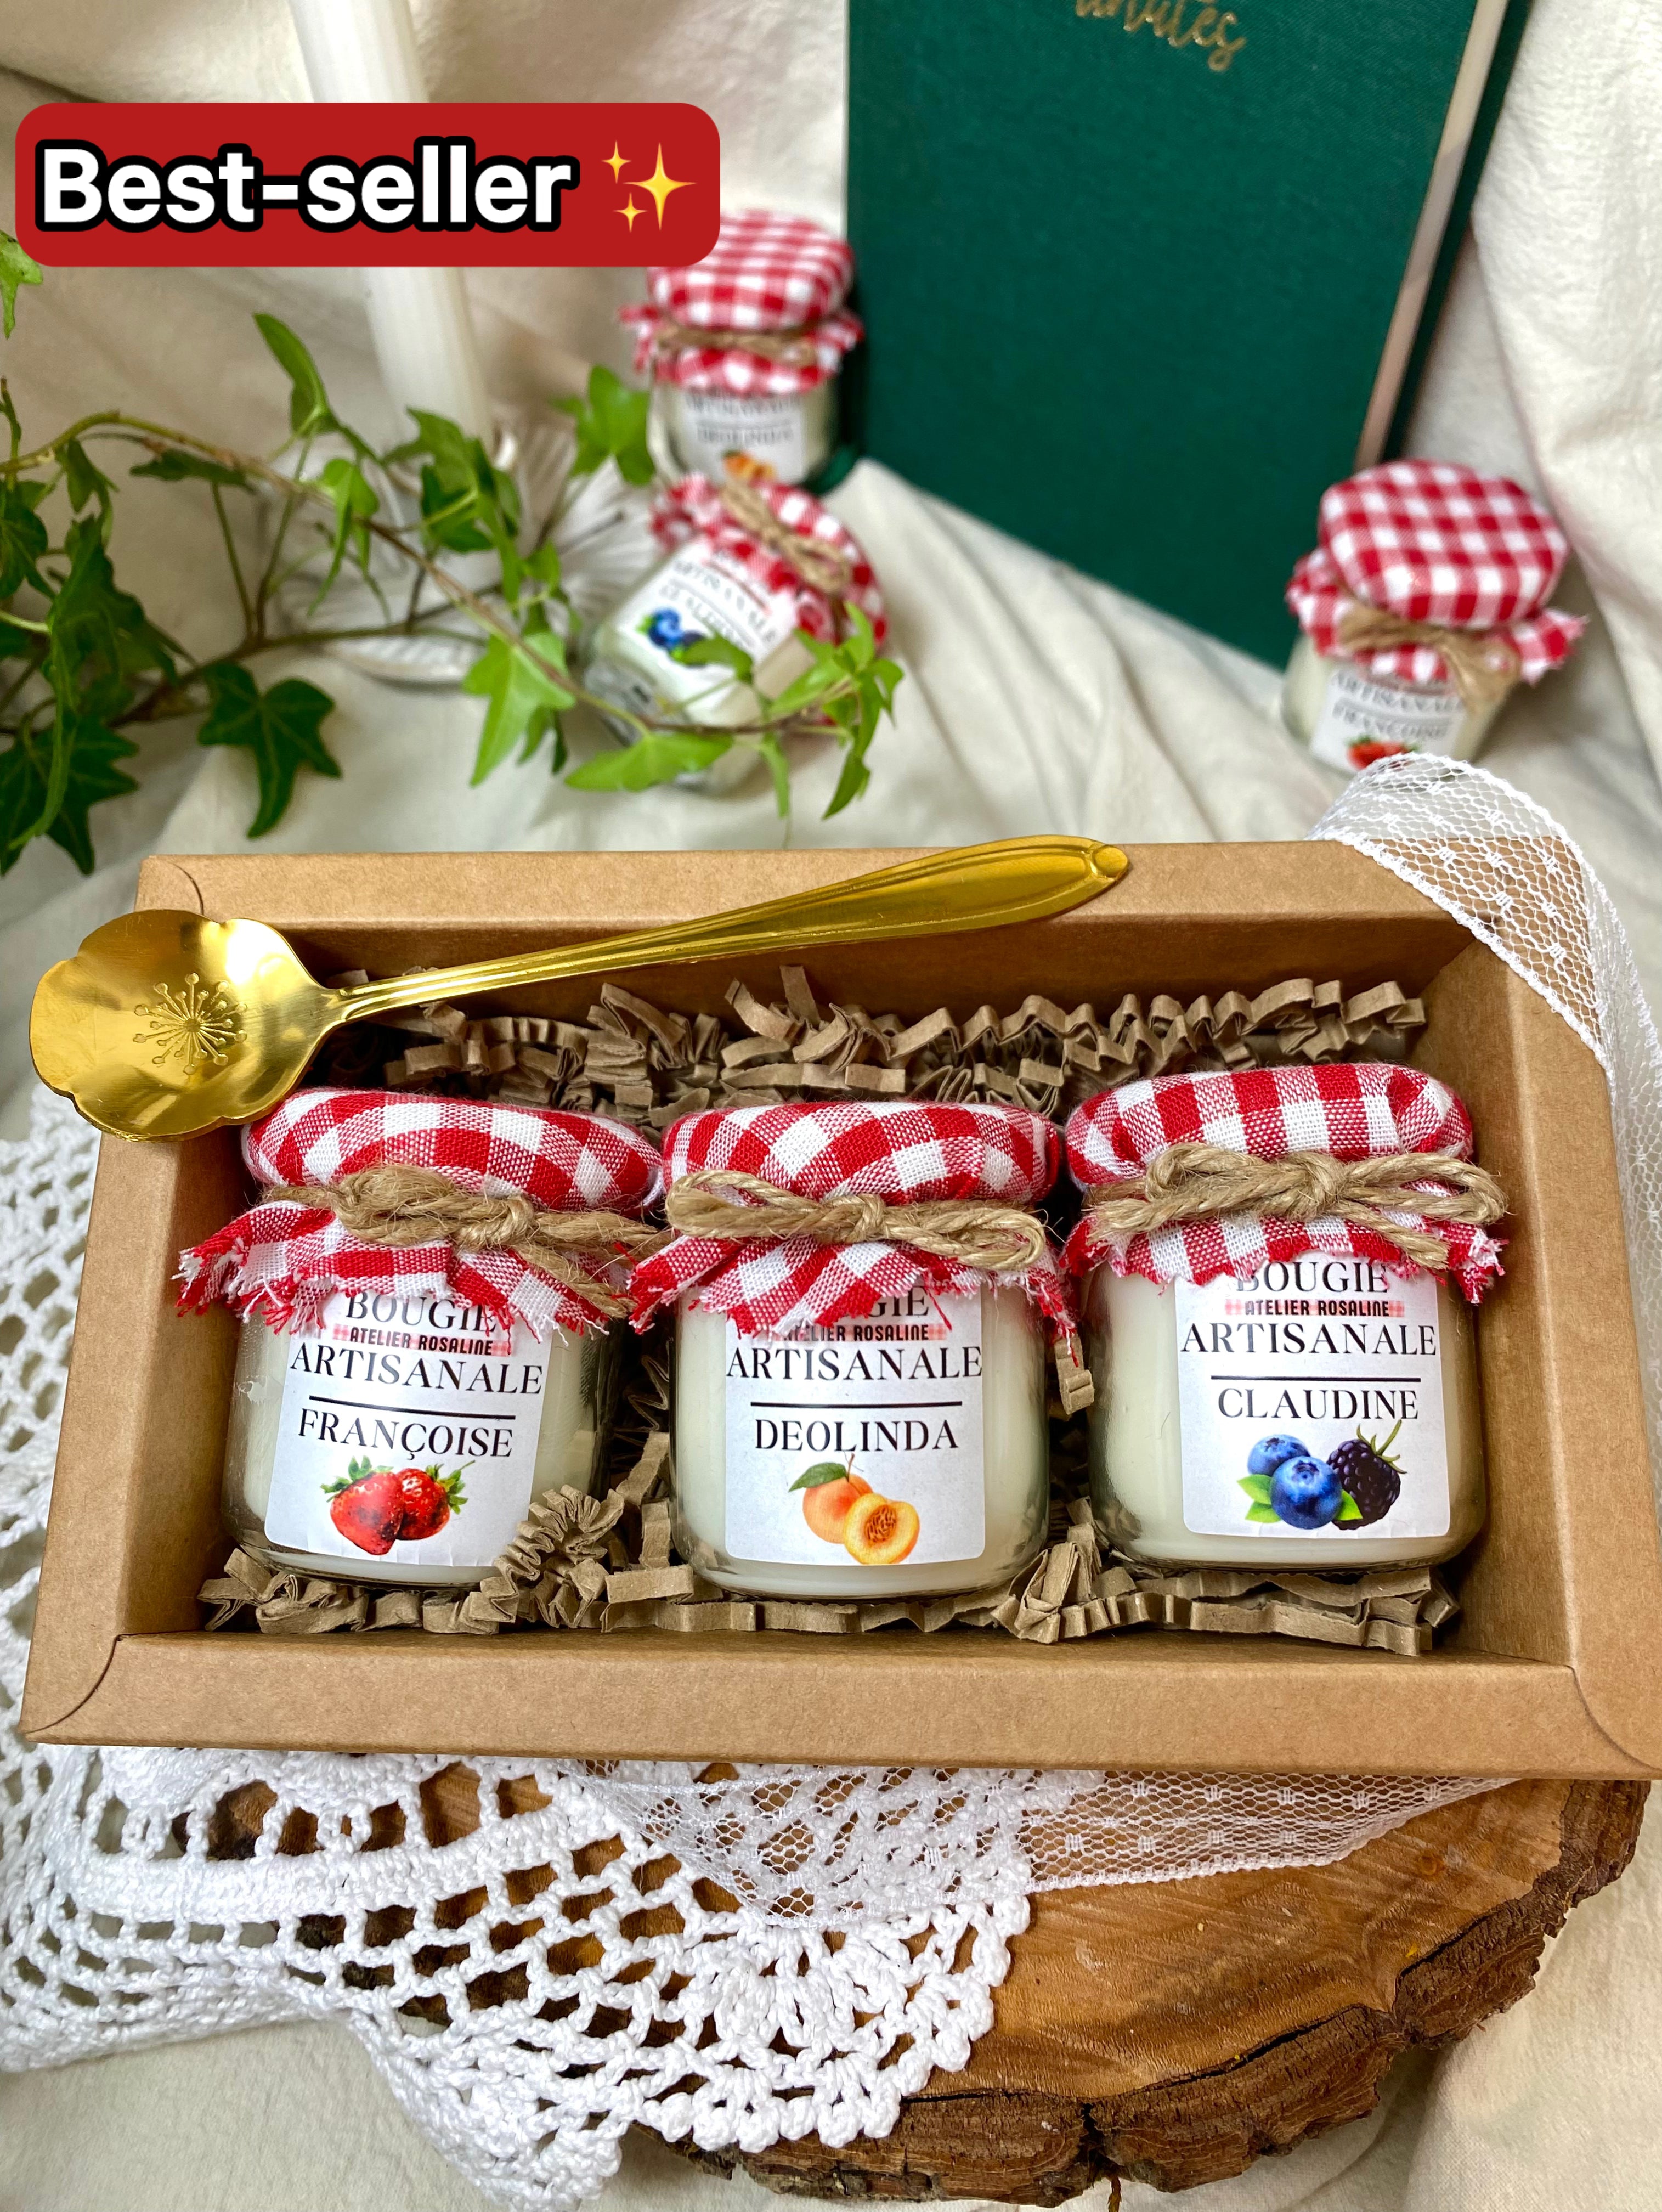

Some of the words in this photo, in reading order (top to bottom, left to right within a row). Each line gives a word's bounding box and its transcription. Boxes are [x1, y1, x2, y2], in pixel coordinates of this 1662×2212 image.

[1245, 1300, 1310, 1316] ATELIER
[1318, 1300, 1389, 1317] ROSALINE
[350, 1327, 411, 1348] ATELIER
[418, 1334, 494, 1356] ROSALINE
[853, 1324, 929, 1341] ROSALINE
[1180, 1323, 1437, 1355] ARTISANALE
[290, 1342, 543, 1395] ARTISANALE
[726, 1346, 982, 1381] ARTISANALE
[1218, 1387, 1419, 1420] CLAUDINE
[298, 1408, 513, 1460] FRANÇOISE
[755, 1419, 959, 1452] DEOLINDA
